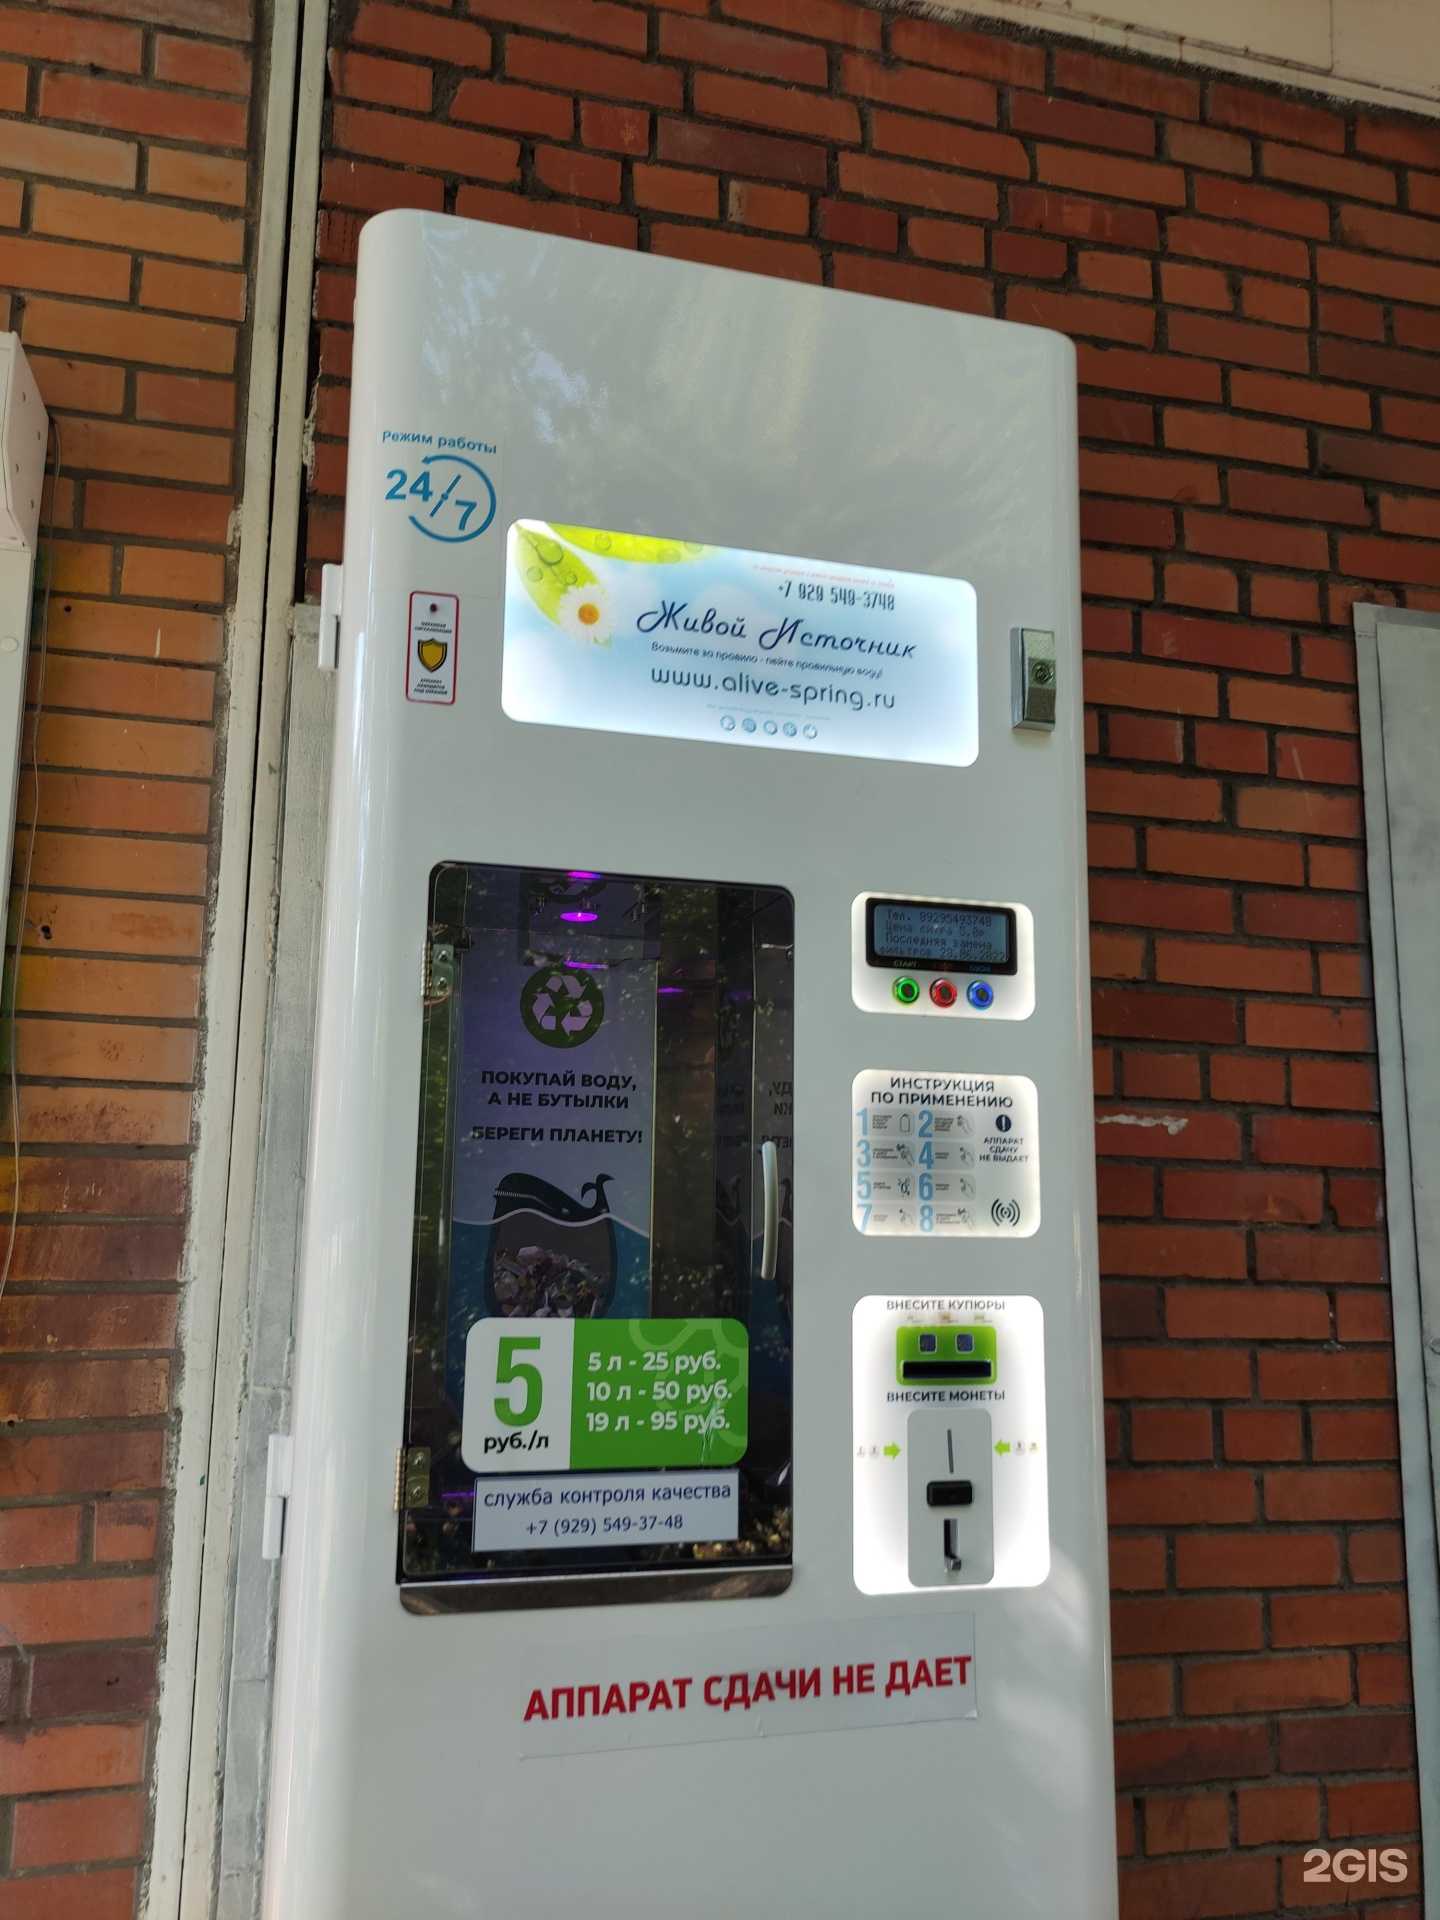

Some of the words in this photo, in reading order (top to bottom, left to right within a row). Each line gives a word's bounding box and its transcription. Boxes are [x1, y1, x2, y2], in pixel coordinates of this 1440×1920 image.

[382, 430, 433, 444] Режим
[438, 436, 497, 454] работы
[385, 468, 478, 531] 24/7
[778, 580, 792, 598] +7
[636, 600, 747, 639] Живой
[758, 617, 918, 659] Источник
[650, 667, 896, 712] www.alive-spring.ru
[481, 1070, 576, 1087] ПОКУПАЙ
[581, 1074, 637, 1091] ВОДУ,
[890, 1077, 995, 1094] ИНСТРУКЦИЯ
[488, 1092, 501, 1105] А
[507, 1093, 533, 1106] НЕ
[538, 1094, 629, 1109] БУТЫЛКИ
[871, 1092, 894, 1104] ПО
[899, 1092, 1014, 1109] ПРИМЕНЕНИЮ
[471, 1126, 544, 1141] БЕРЕГИ
[550, 1128, 643, 1144] ПЛАНЕТУ!
[856, 1108, 869, 1137] 1
[918, 1109, 934, 1138] 2
[856, 1139, 871, 1168] 3
[983, 1136, 1024, 1145] АППАРАТ
[918, 1141, 934, 1170] 4
[856, 1172, 872, 1200] 5
[918, 1172, 934, 1201] 6
[856, 1204, 873, 1233] 7
[919, 1204, 934, 1232] 8
[886, 1300, 945, 1310] ВНЕСИТЕ
[949, 1300, 1005, 1311] КУПЮРЫ
[588, 1352, 602, 1371] 5
[606, 1356, 622, 1371] л
[642, 1352, 669, 1371] 25
[675, 1350, 721, 1375] руб.
[494, 1336, 543, 1427] 5
[586, 1382, 611, 1401] 10
[616, 1385, 631, 1401] л
[652, 1381, 680, 1400] 50
[686, 1379, 732, 1405] руб.
[886, 1391, 946, 1402] ВНЕСИТЕ
[950, 1390, 1005, 1402] МОНЕТЫ
[586, 1413, 609, 1432] 19
[615, 1416, 629, 1431] л
[651, 1412, 677, 1430] 95
[684, 1409, 730, 1435] руб.
[484, 1430, 549, 1454] руб./л
[484, 1488, 553, 1510] служба
[560, 1487, 645, 1507] контроля
[652, 1483, 732, 1501] качества
[526, 1520, 547, 1536] +7
[554, 1517, 597, 1537] (929)
[603, 1515, 684, 1533] 549-37-48
[523, 1678, 693, 1722] АППАРАТ
[703, 1668, 821, 1712] СДАЧИ
[832, 1664, 876, 1696] НЕ
[885, 1656, 972, 1698] ДАЕТ
